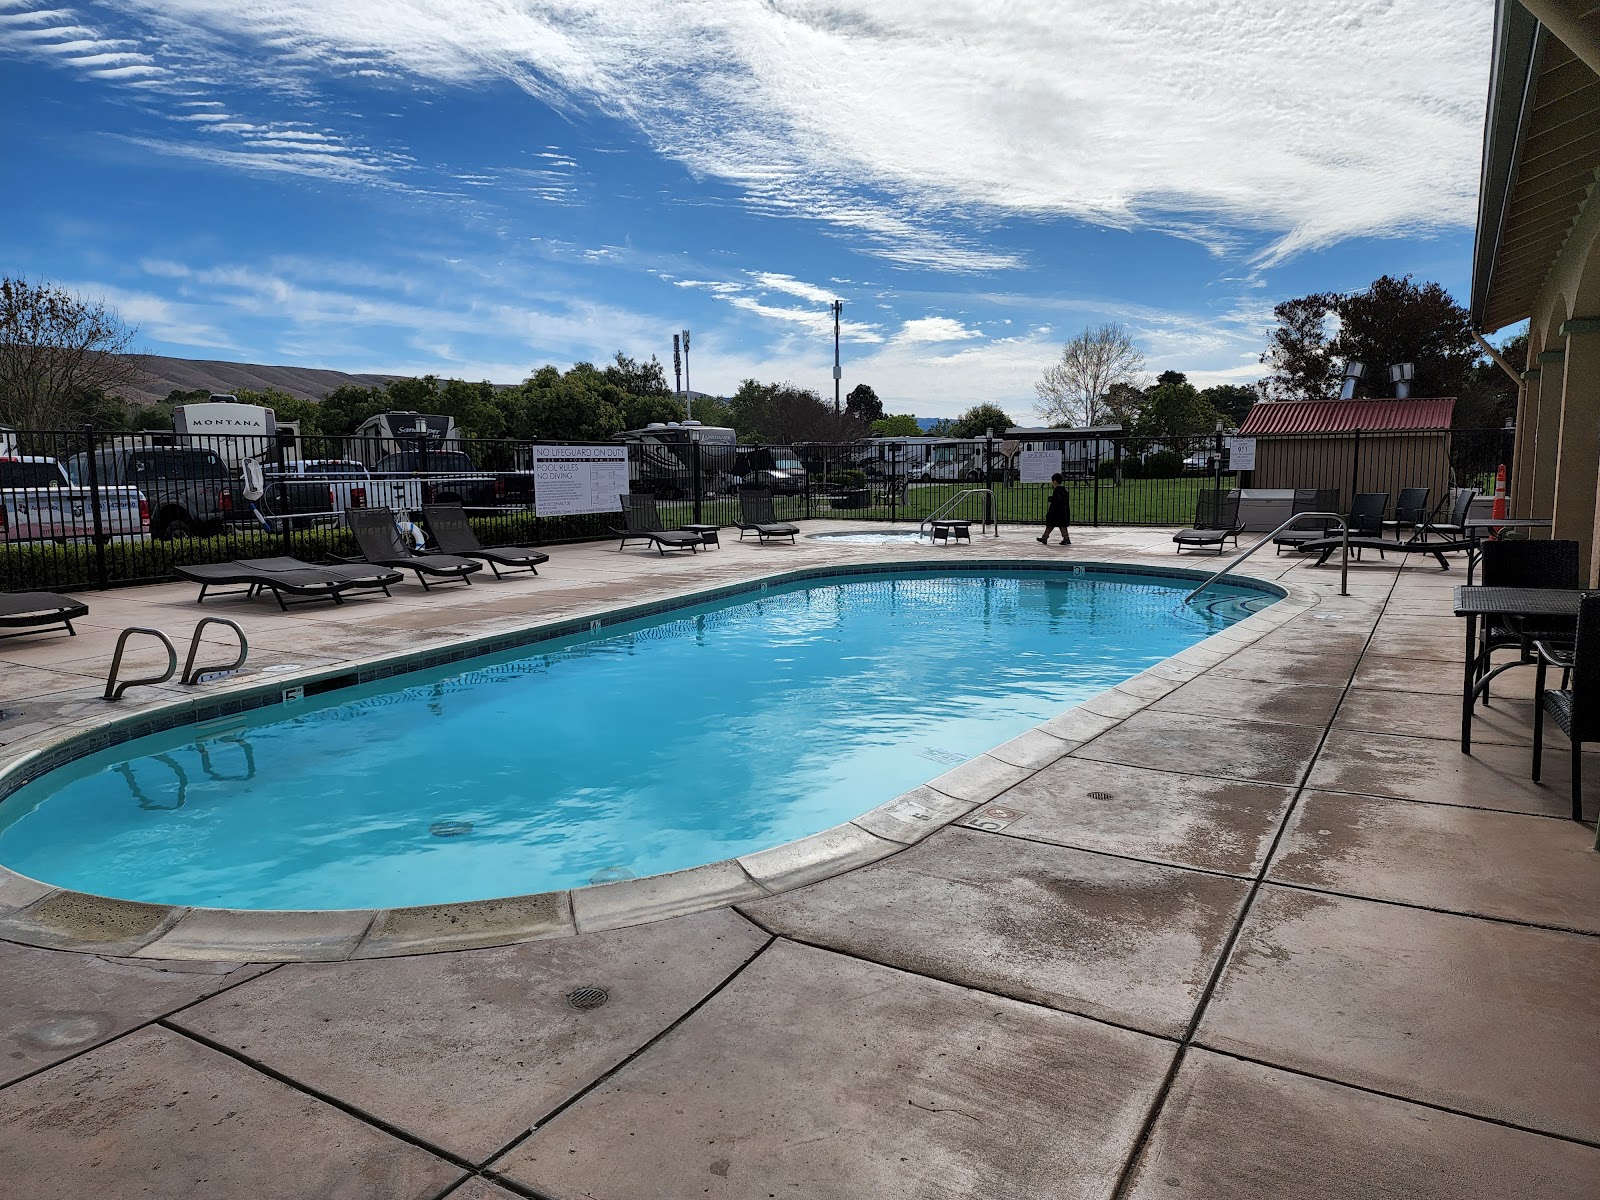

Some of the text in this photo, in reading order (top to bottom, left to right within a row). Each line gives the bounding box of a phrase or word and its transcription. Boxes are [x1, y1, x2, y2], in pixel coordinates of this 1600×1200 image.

[192, 419, 261, 427] MONTANA
[536, 448, 625, 457] NO LIFEGUARD ON DUTY
[536, 463, 579, 472] POOL RULES
[537, 472, 573, 480] NO DIVING
